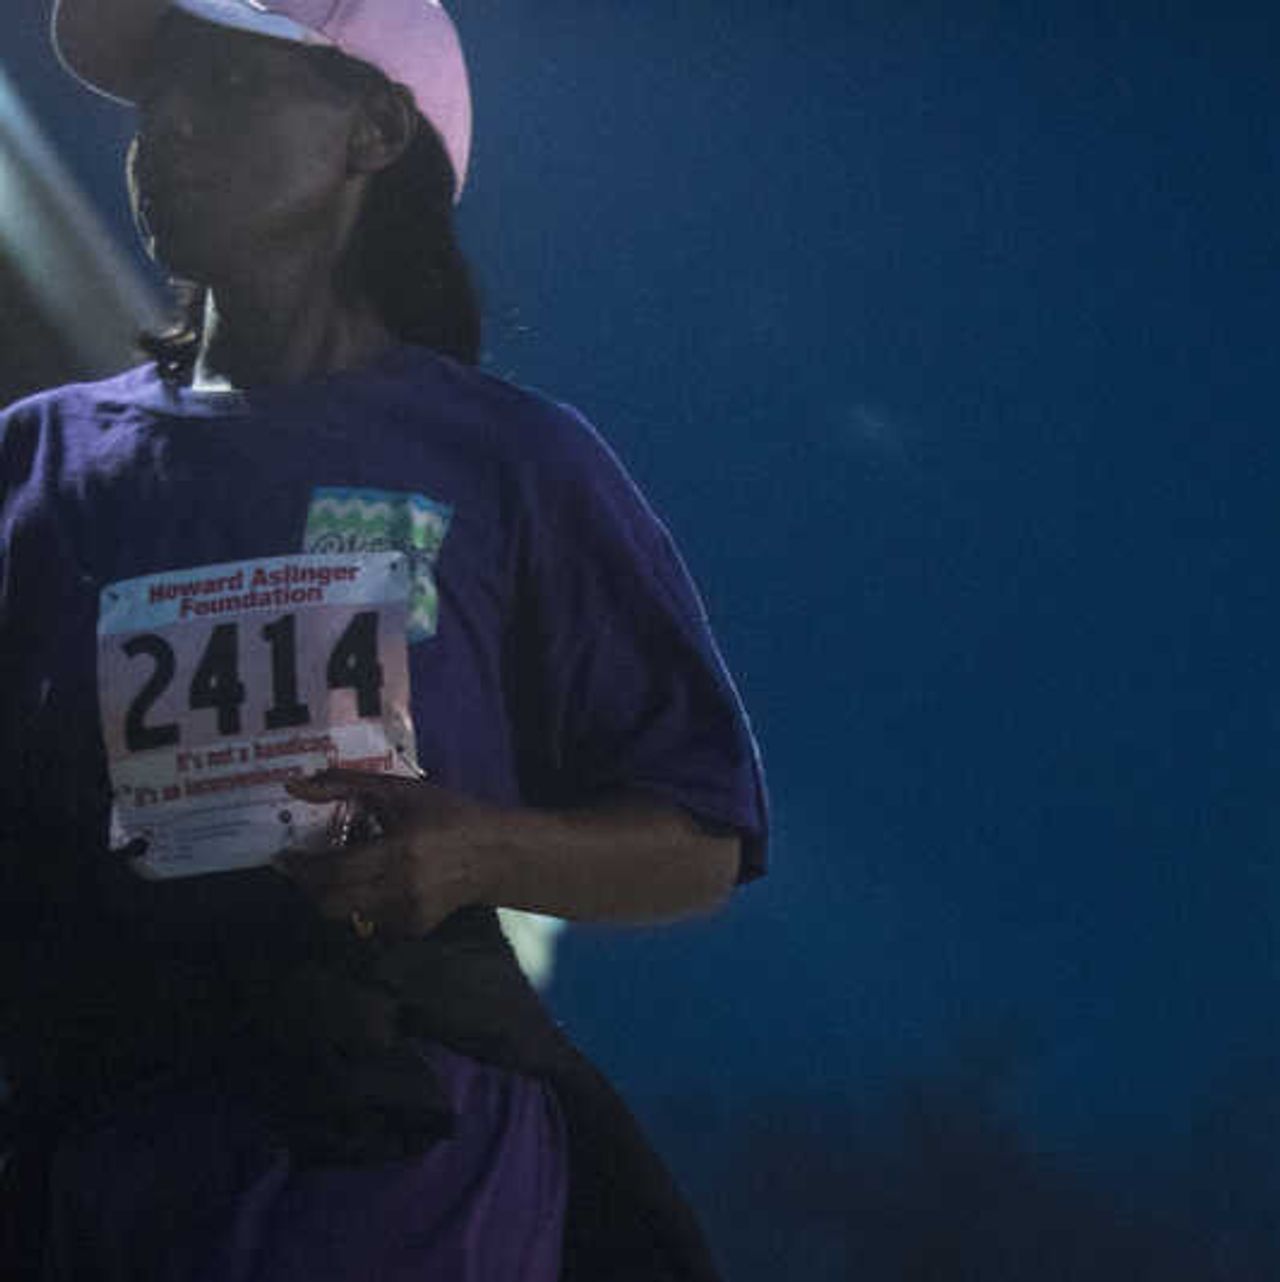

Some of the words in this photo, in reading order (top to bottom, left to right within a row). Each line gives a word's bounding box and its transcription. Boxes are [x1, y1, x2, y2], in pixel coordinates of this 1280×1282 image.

[147, 570, 243, 604] Howard
[251, 561, 360, 592] Aslinger
[178, 586, 323, 617] Foundation
[122, 611, 384, 753] 2414
